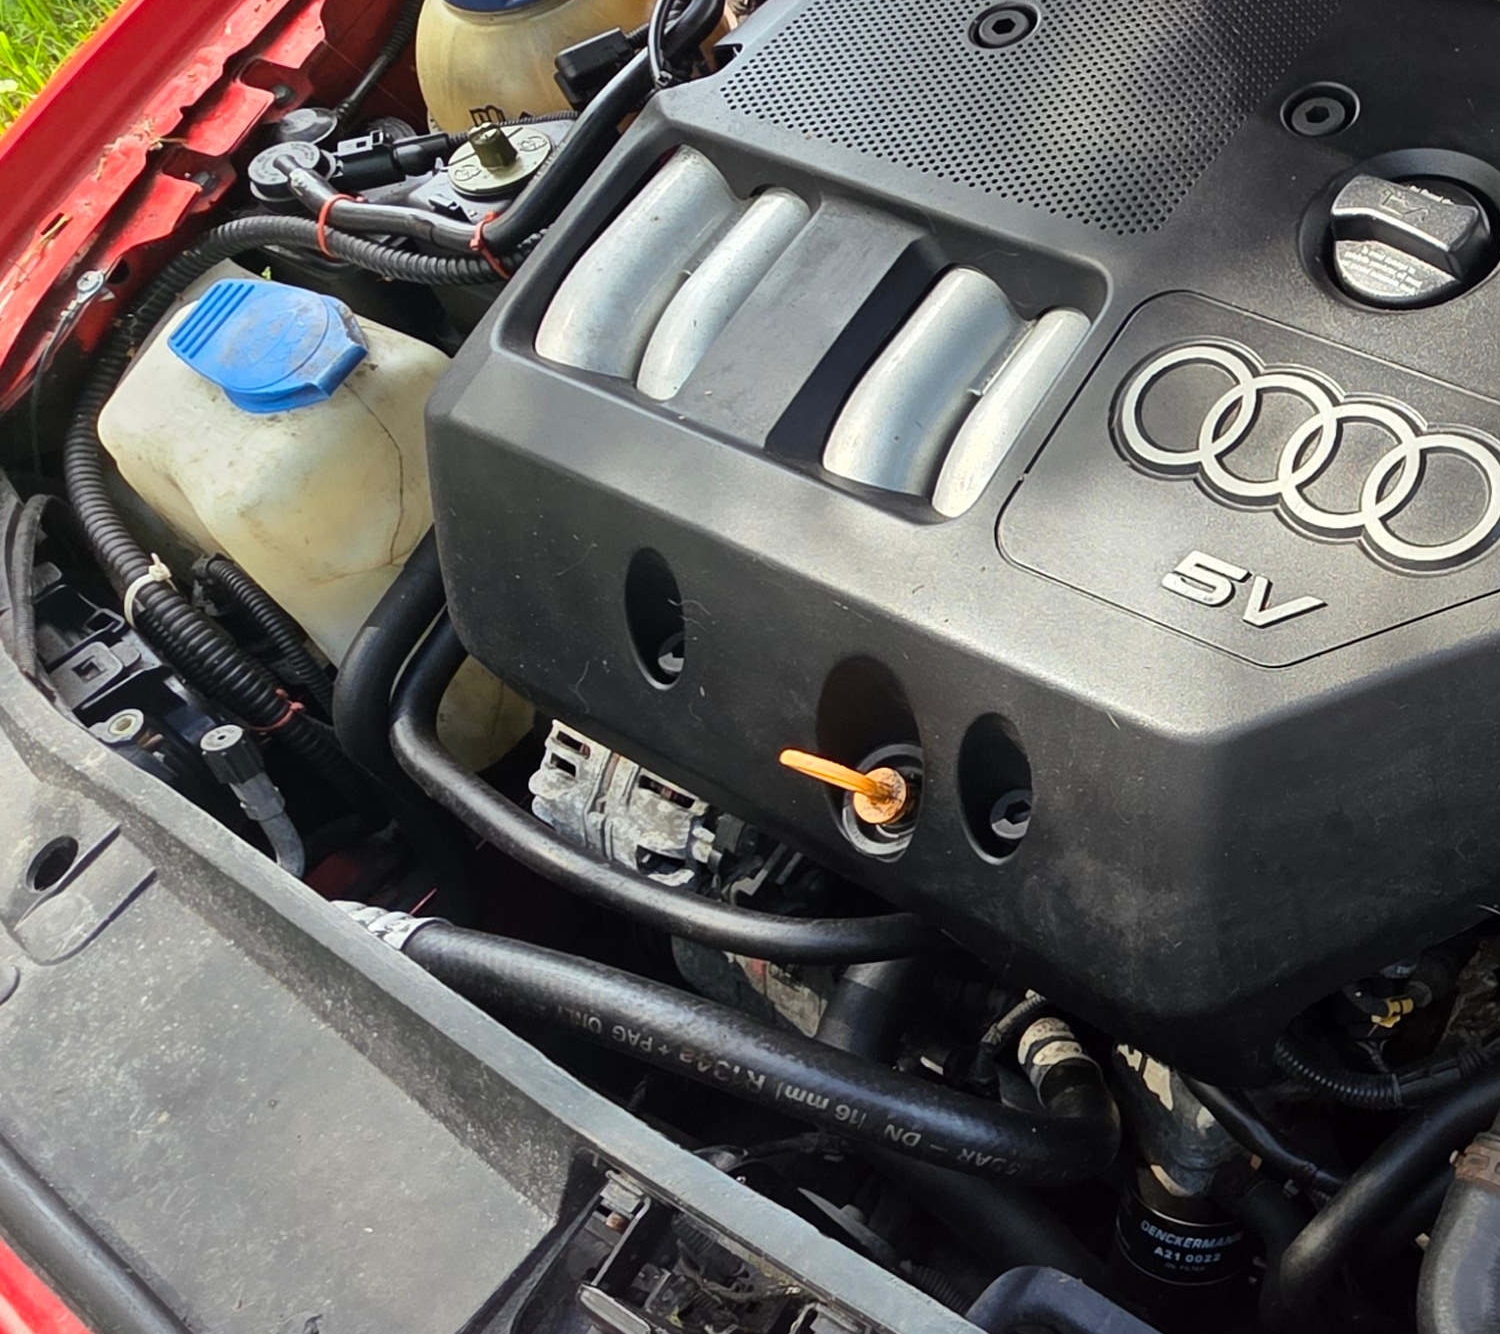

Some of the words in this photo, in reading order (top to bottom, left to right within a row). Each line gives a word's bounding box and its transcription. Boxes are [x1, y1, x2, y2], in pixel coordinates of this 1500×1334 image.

[1161, 549, 1327, 628] 5V
[611, 1025, 653, 1052] PAG
[882, 1123, 921, 1147] DN
[1153, 1246, 1181, 1261] A21
